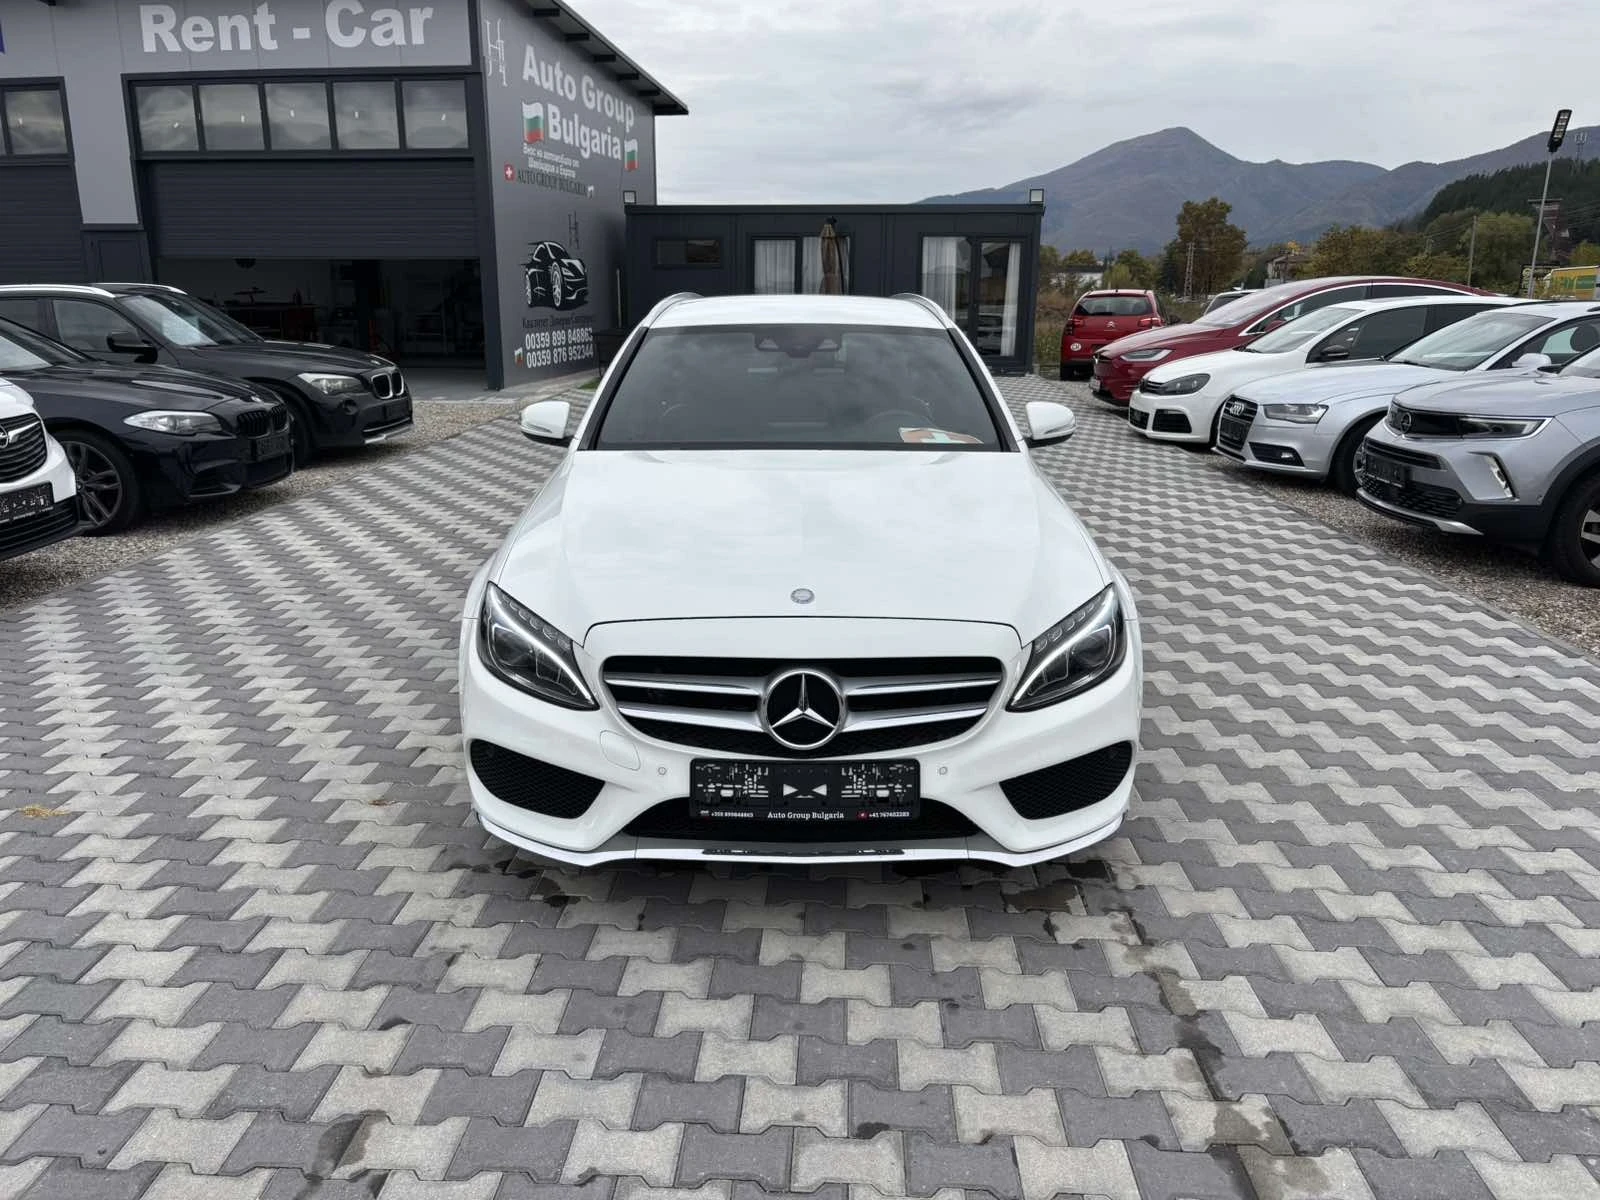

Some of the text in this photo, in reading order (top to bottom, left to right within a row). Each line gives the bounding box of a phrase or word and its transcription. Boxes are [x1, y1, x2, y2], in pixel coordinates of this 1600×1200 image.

[139, 2, 278, 53] Rent
[324, 0, 434, 49] Car
[522, 44, 577, 101] Auto
[581, 75, 634, 132] Group
[547, 103, 622, 160] Bulgaria
[525, 331, 551, 350] 00359
[552, 329, 567, 347] 899
[526, 348, 552, 369] 00359
[553, 347, 567, 364] 876
[767, 810, 845, 821] Auto Group Bulgaria
